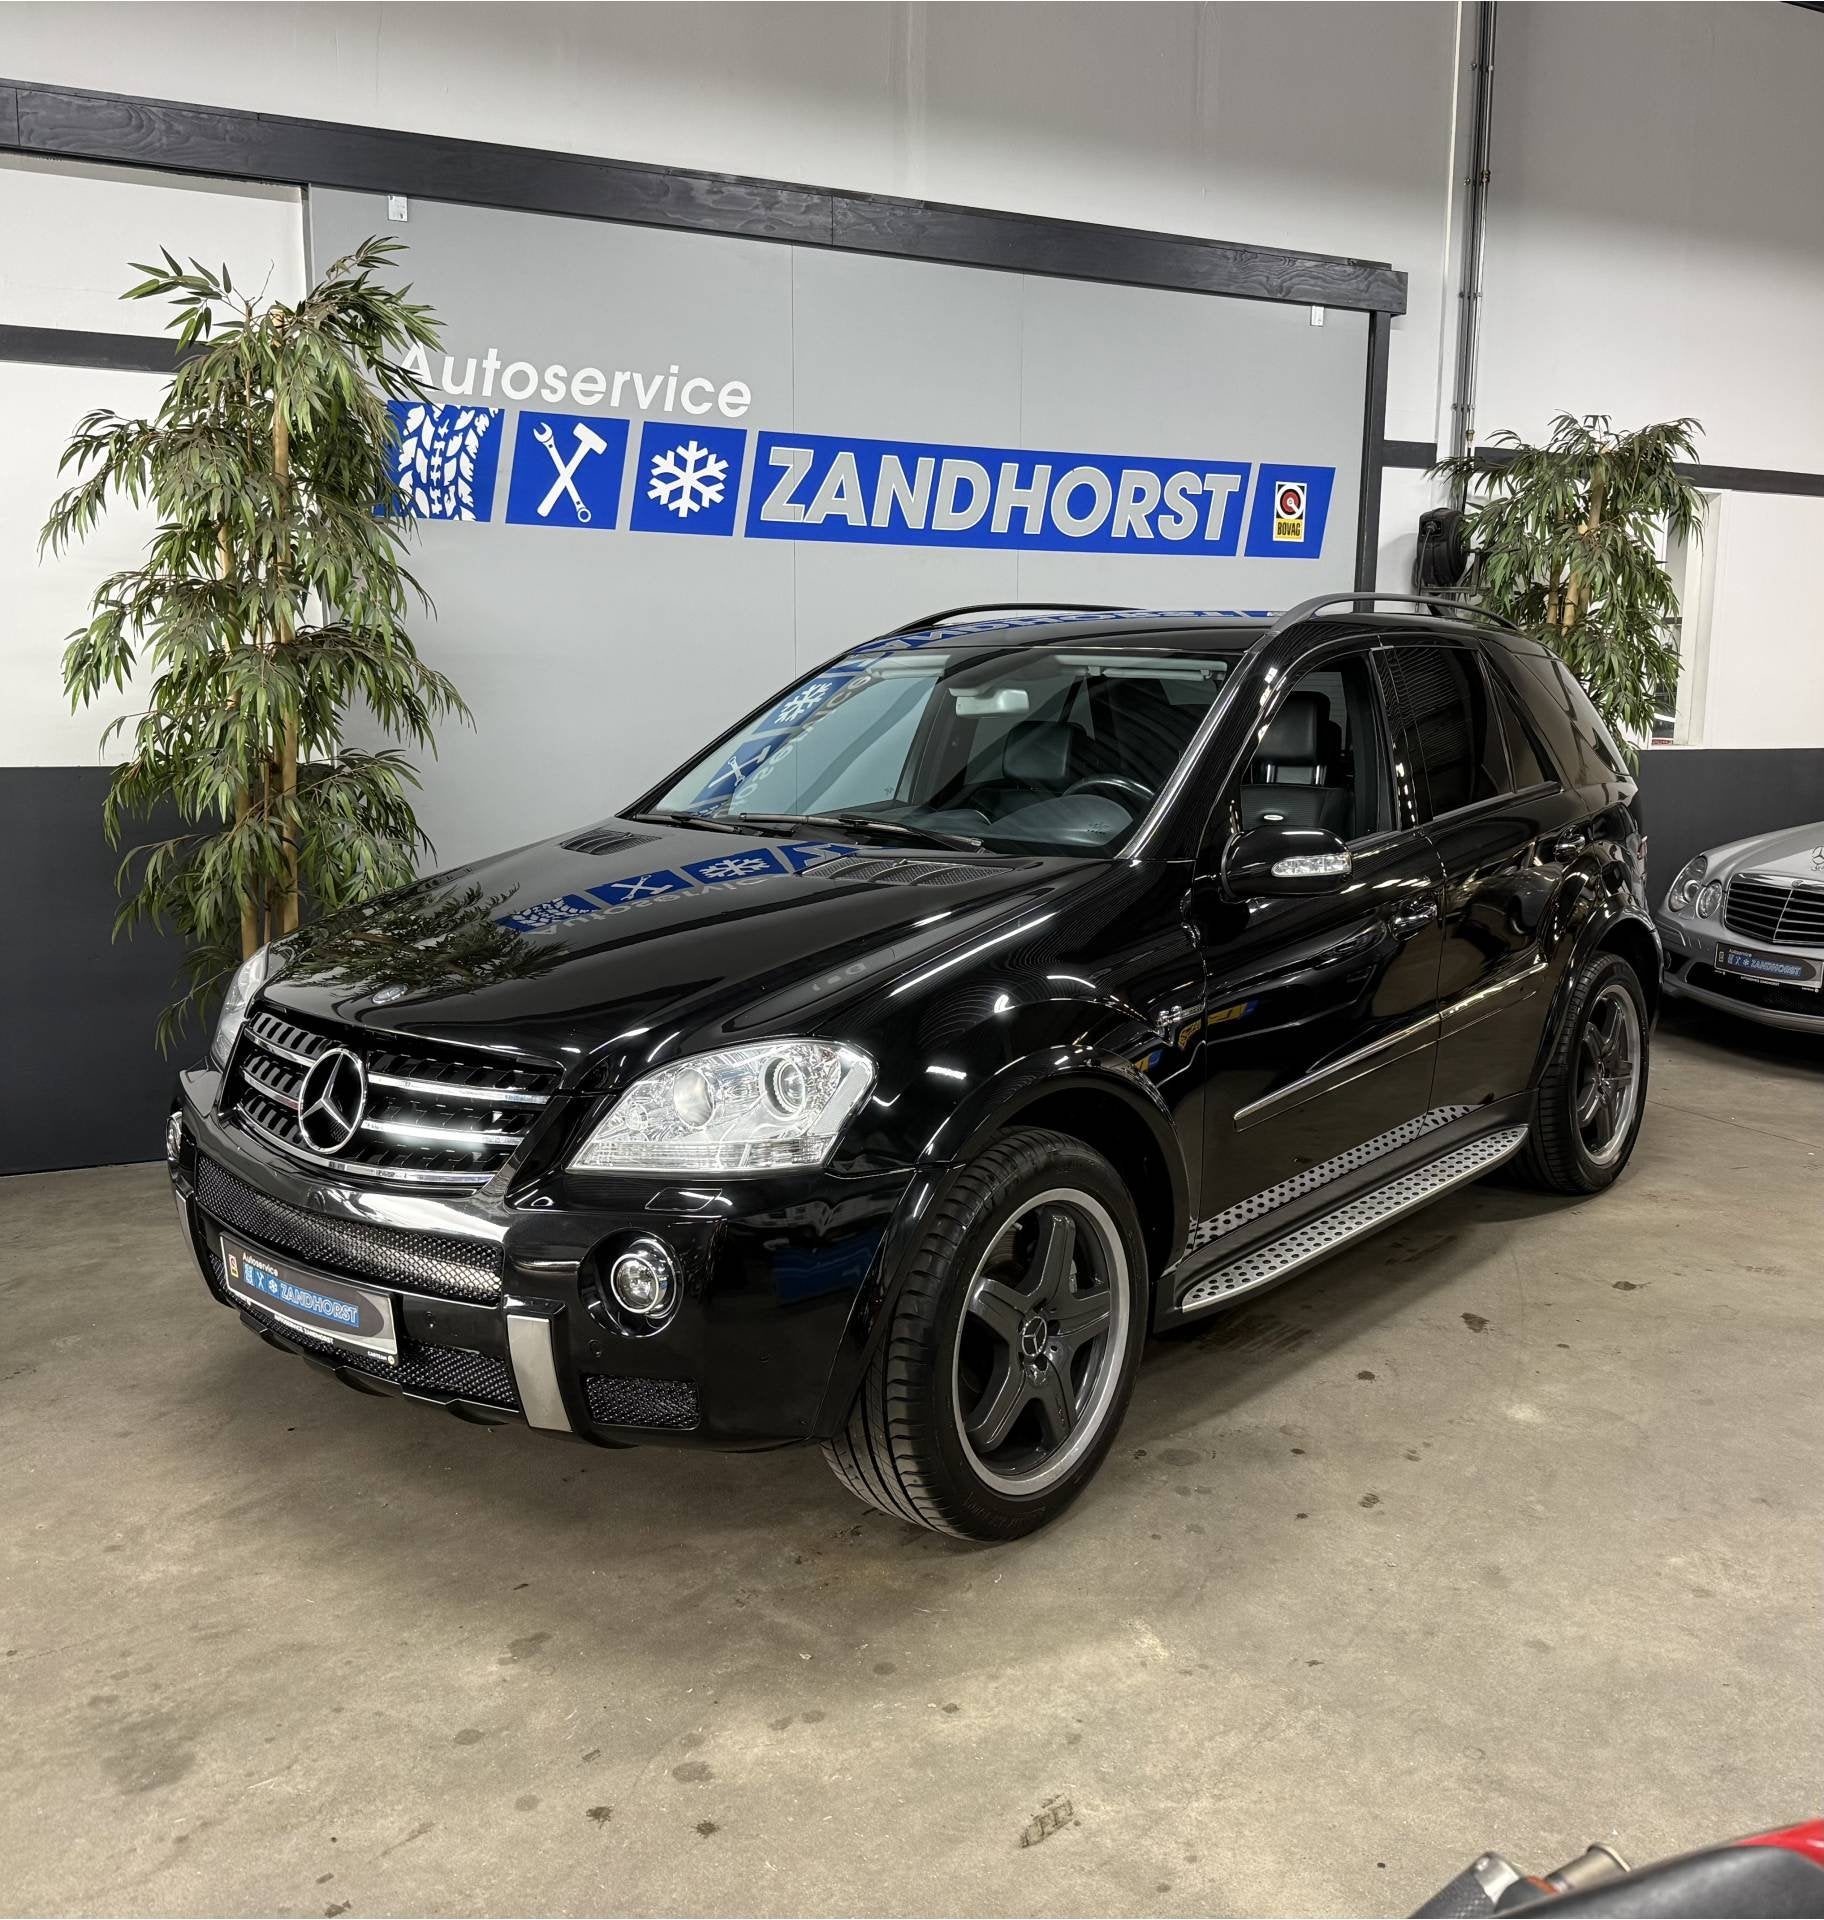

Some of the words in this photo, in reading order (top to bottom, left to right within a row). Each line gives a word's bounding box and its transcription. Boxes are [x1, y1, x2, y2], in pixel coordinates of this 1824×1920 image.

[391, 340, 752, 418] Autoservice
[759, 446, 1242, 541] ZANDHORST
[1276, 521, 1301, 537] BOVAG
[242, 1252, 279, 1277] Autoservice
[280, 1282, 359, 1324] ZANDHORST
